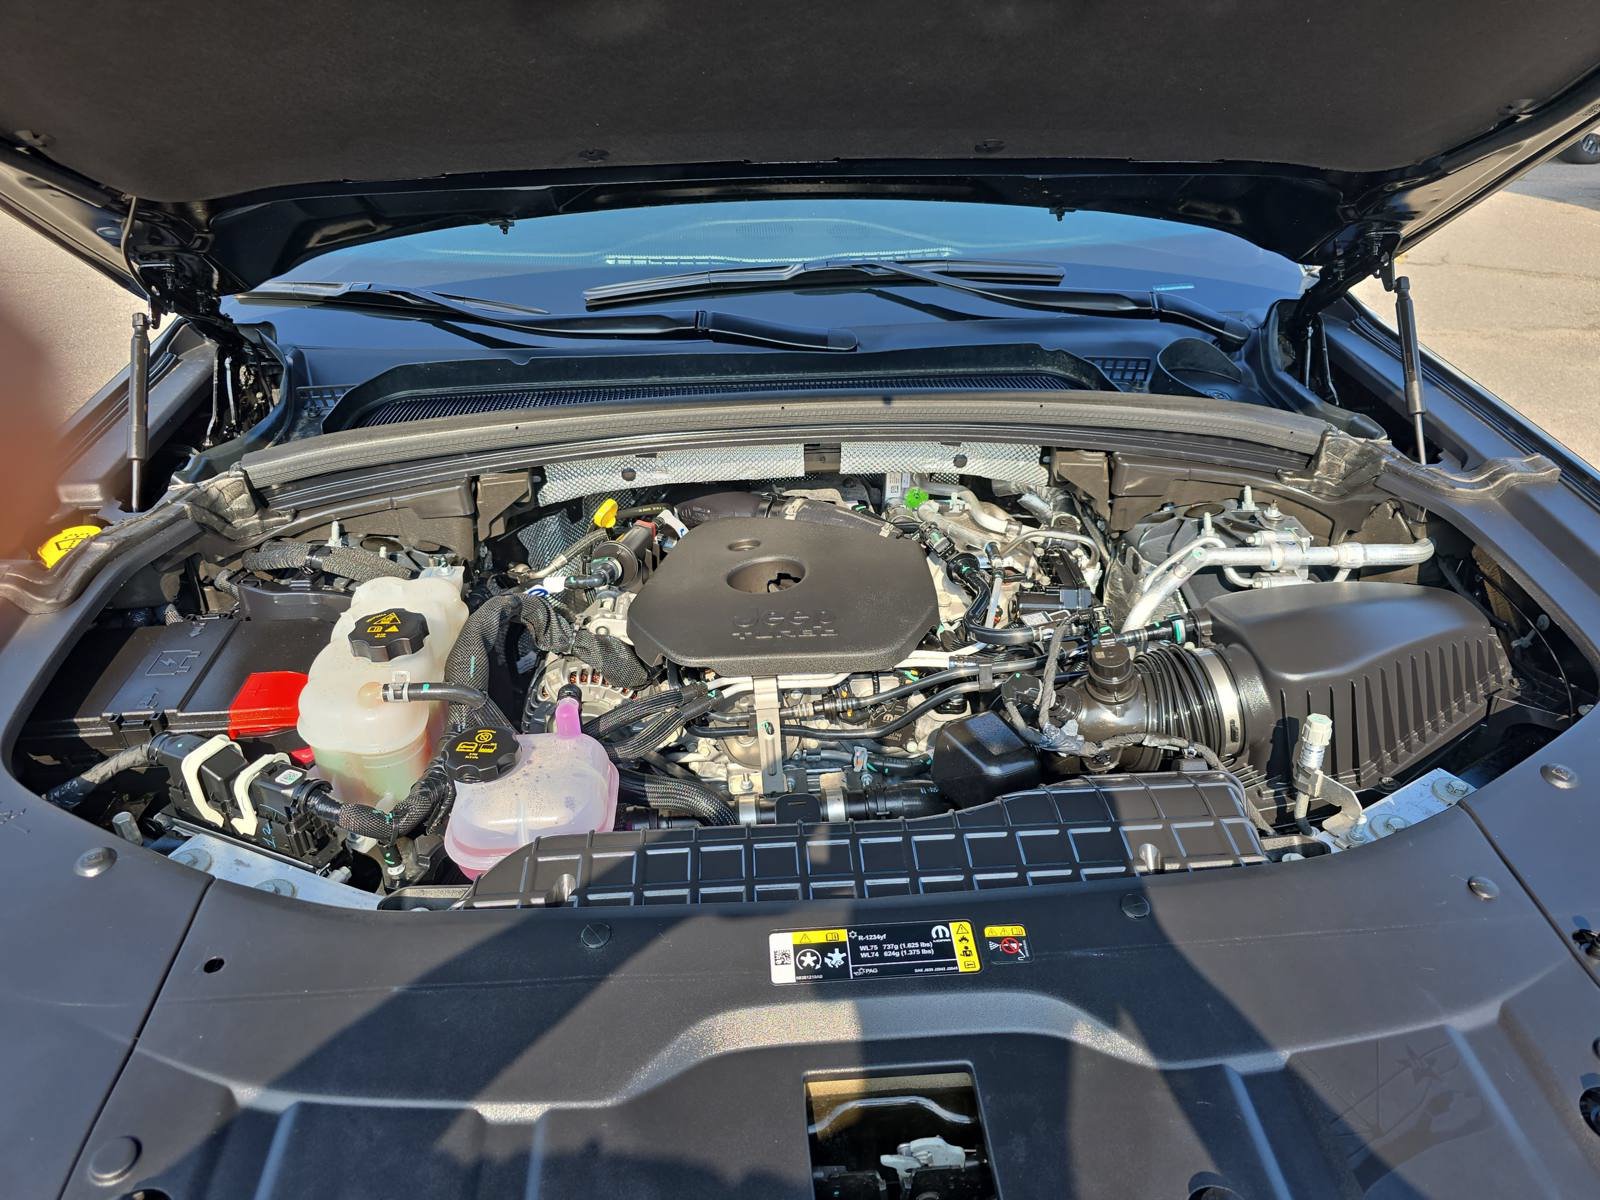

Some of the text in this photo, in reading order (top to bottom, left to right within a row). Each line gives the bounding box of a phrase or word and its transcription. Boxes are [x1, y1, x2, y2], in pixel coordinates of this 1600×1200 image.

[858, 933, 887, 941] R-1234yf
[859, 944, 879, 952] WL75
[882, 943, 899, 951] 737g
[860, 951, 880, 959] WL74
[900, 949, 921, 958] (1.375
[921, 948, 935, 956] lbs)
